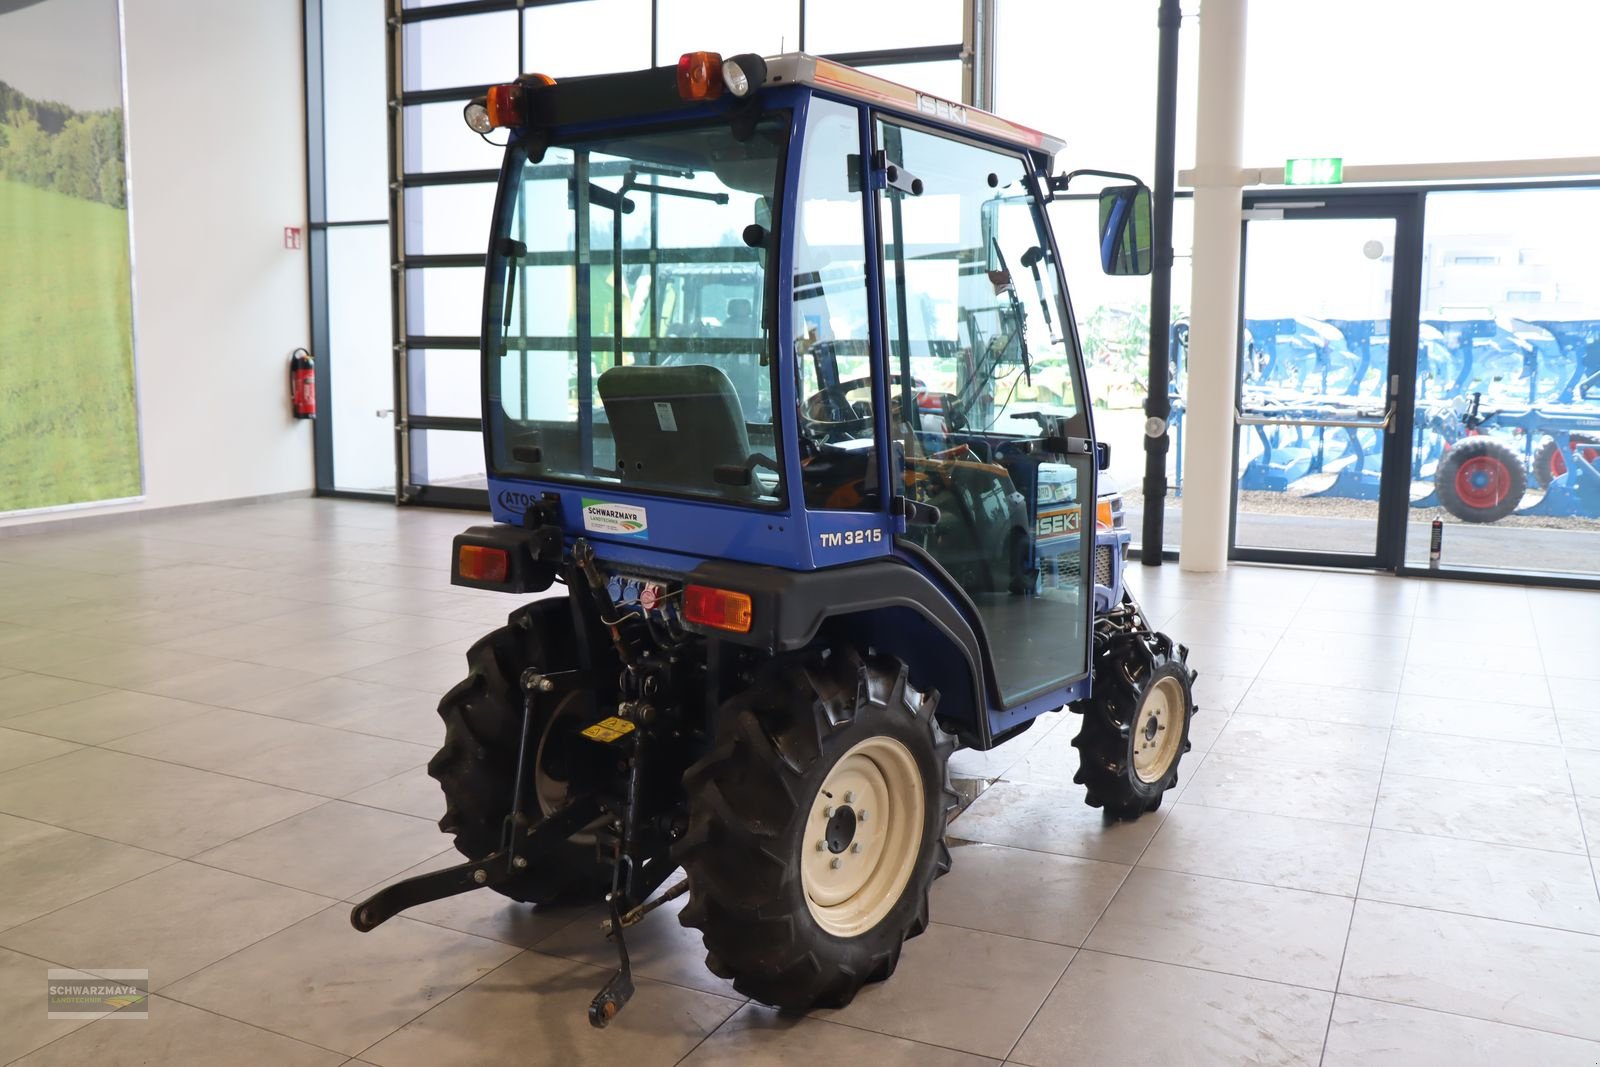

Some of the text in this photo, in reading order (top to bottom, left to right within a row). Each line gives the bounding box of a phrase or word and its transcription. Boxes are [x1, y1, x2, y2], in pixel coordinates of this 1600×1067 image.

[916, 92, 967, 126] ISEKI
[505, 491, 537, 506] ATOS
[588, 506, 638, 521] SCHWARZMAYR
[1036, 512, 1079, 536] ISEKI
[820, 528, 882, 547] TM 3215
